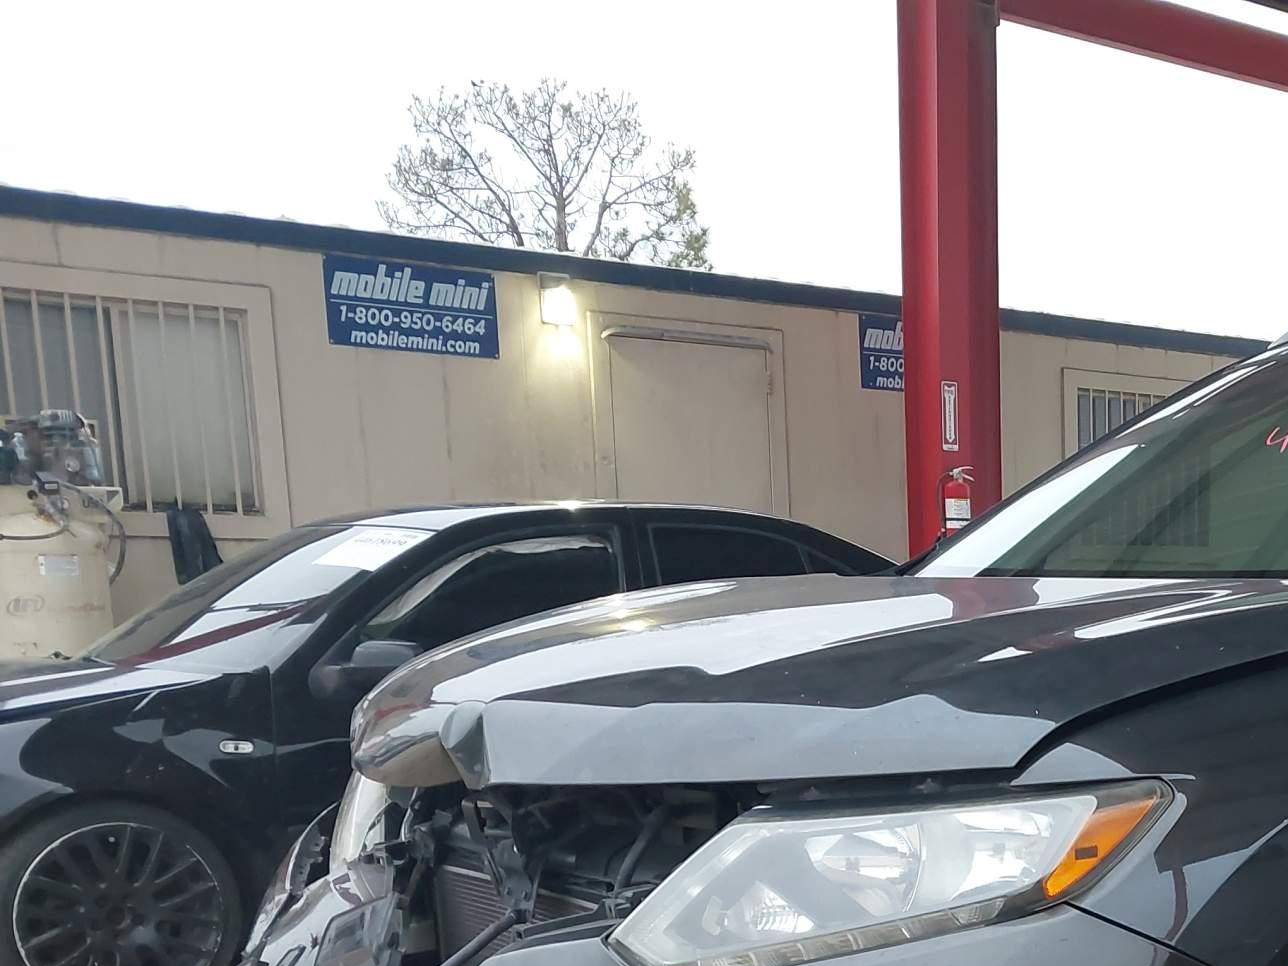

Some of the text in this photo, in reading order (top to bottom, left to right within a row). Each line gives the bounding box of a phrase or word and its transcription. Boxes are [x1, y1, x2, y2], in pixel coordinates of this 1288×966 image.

[330, 264, 489, 311] mobile mini
[339, 305, 486, 336] 1-800-950-6464
[350, 329, 480, 354] mobilemini.com
